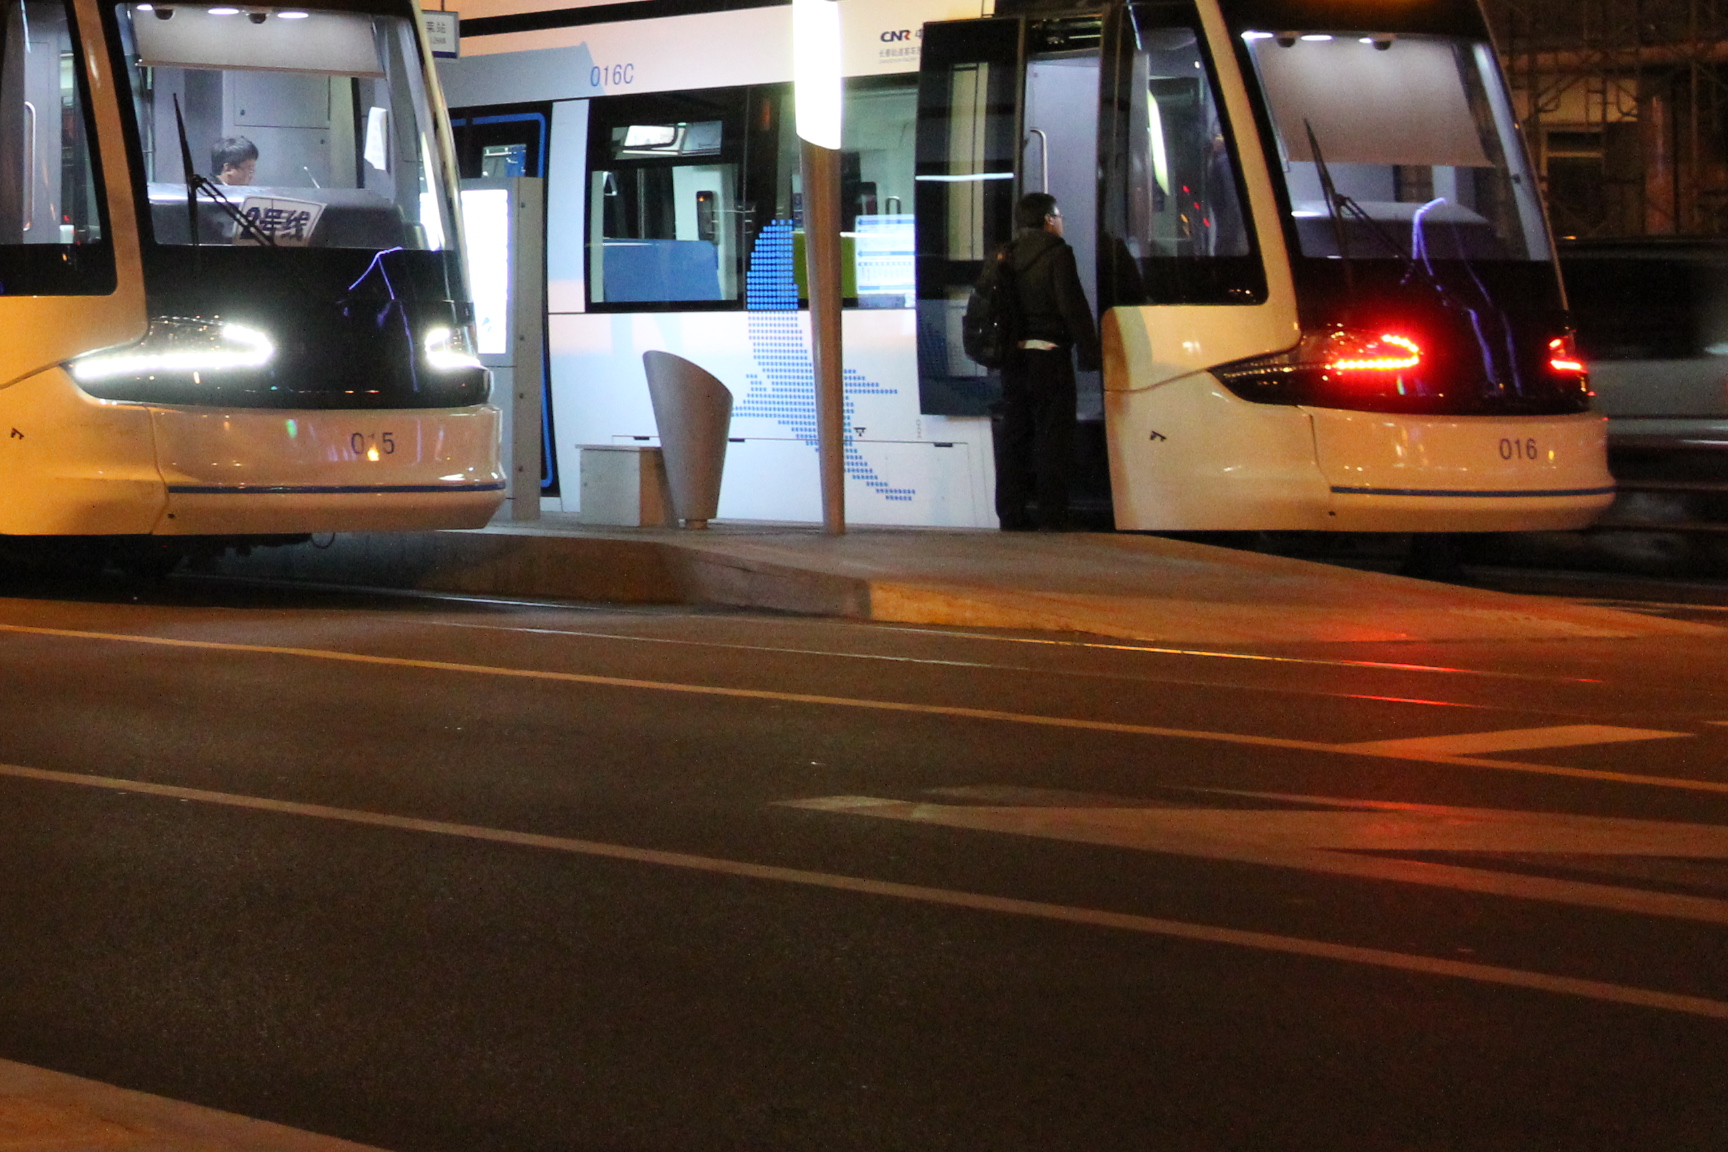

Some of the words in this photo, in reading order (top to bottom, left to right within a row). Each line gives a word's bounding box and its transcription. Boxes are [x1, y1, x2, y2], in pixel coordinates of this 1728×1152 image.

[880, 29, 911, 42] CNR
[590, 63, 634, 87] 016C
[1499, 438, 1538, 460] 016
